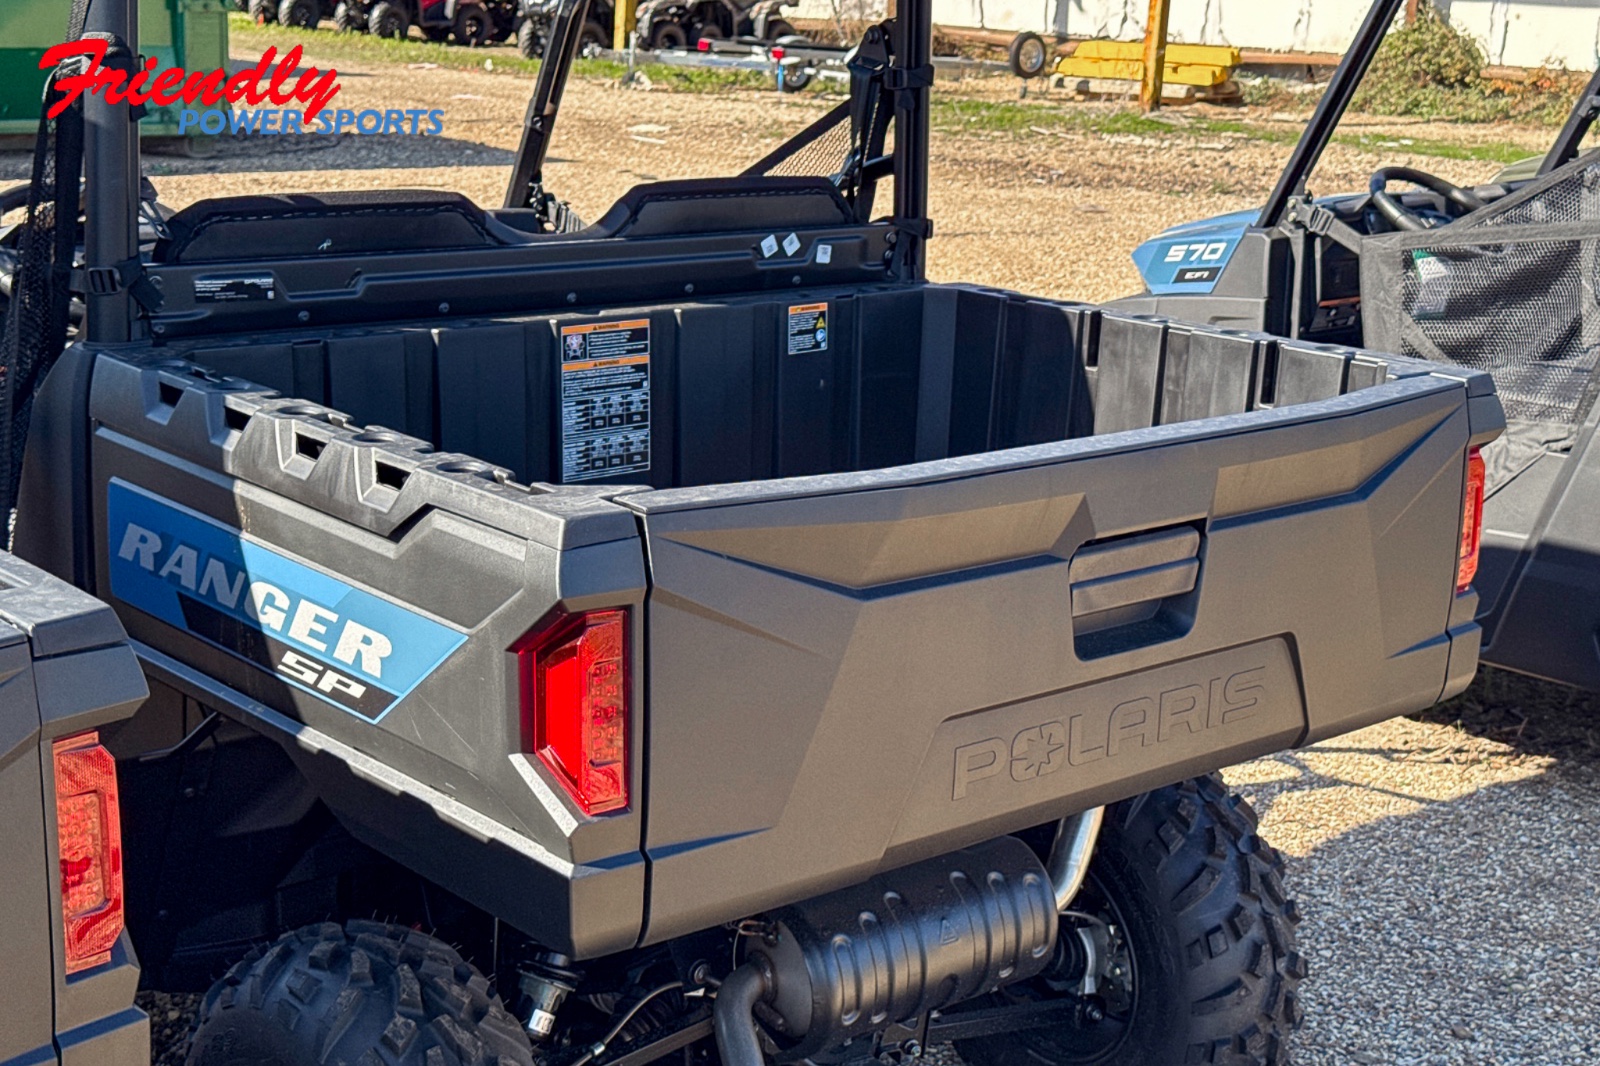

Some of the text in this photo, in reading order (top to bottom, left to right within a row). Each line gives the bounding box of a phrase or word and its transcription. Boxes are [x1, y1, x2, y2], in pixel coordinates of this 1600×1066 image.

[1164, 242, 1227, 262] 570
[1184, 271, 1210, 280] EFI
[117, 522, 393, 679] RANGER
[276, 650, 367, 699] SP
[951, 665, 1266, 802] POLARIS
